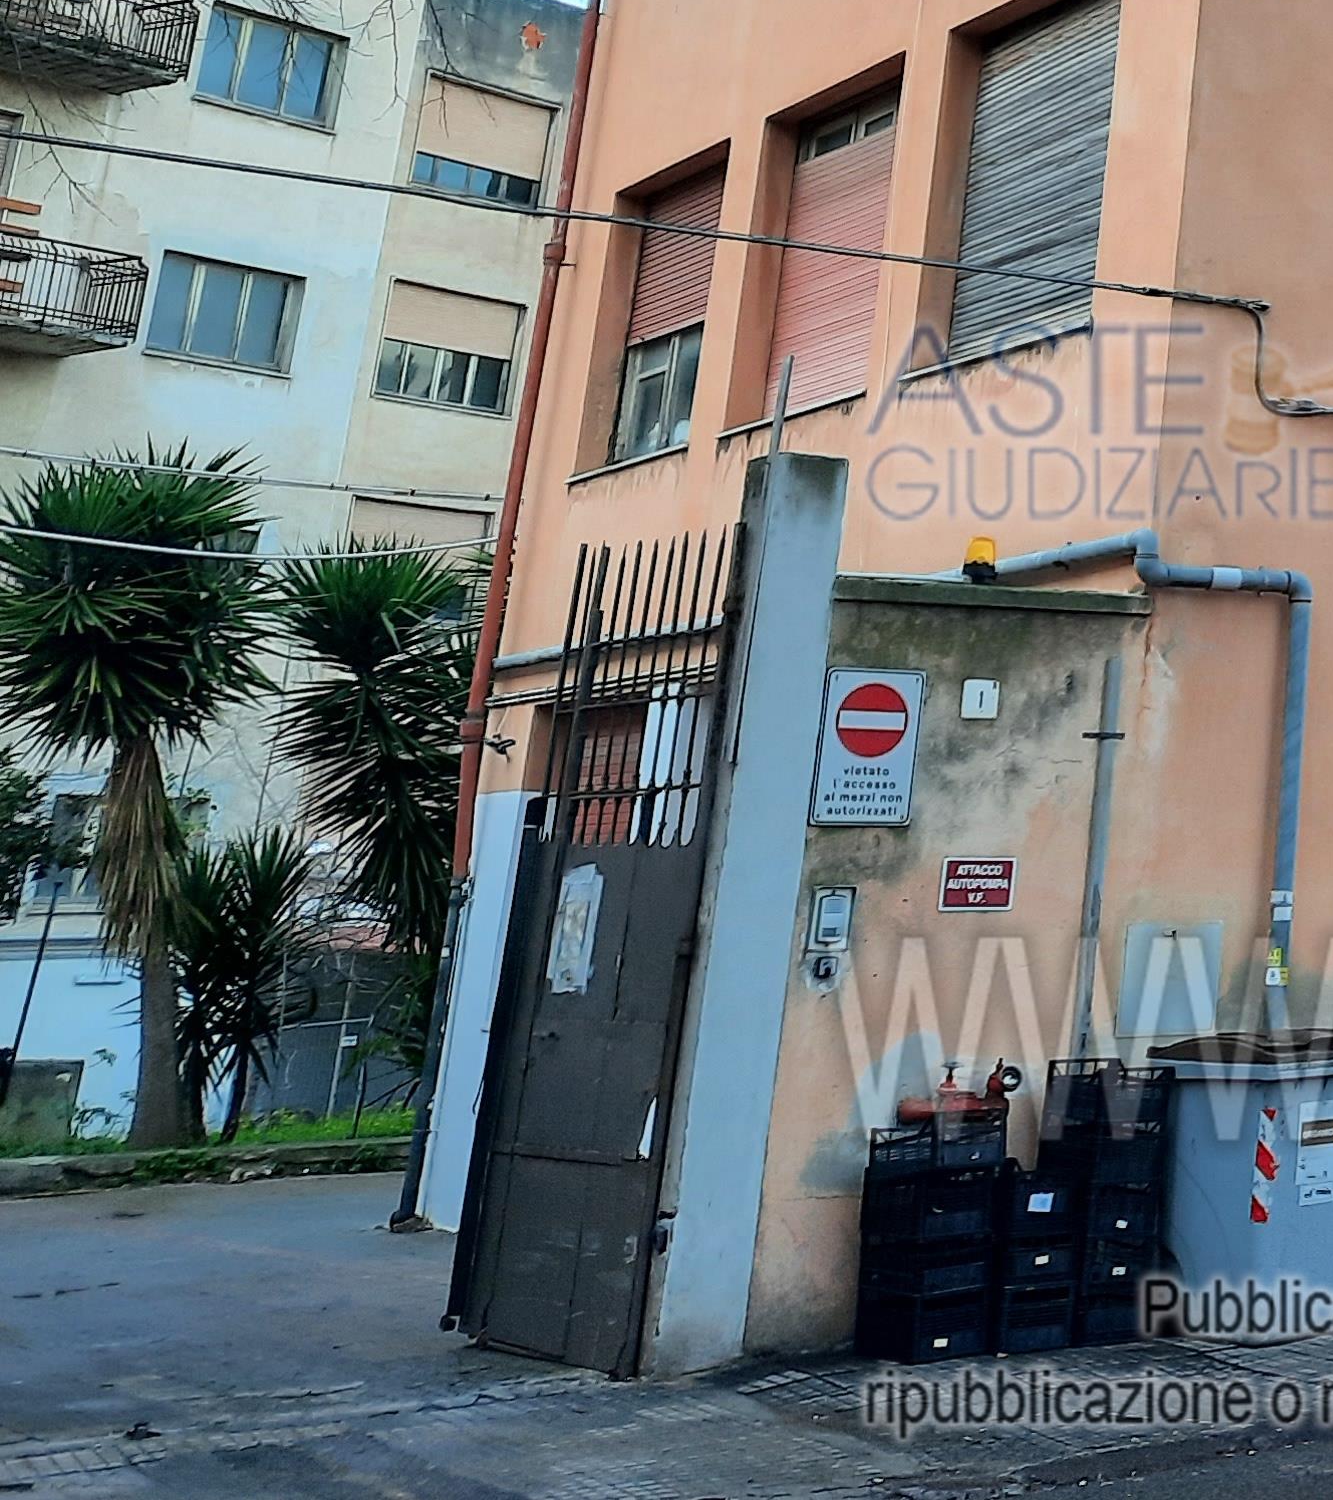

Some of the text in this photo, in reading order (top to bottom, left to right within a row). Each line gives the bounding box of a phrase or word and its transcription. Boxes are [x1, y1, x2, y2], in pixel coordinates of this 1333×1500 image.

[843, 765, 889, 776] vietato
[840, 792, 876, 803] mezzi
[880, 794, 903, 803] non
[826, 806, 897, 817] autorizzati
[955, 865, 1003, 876] ATTACCO
